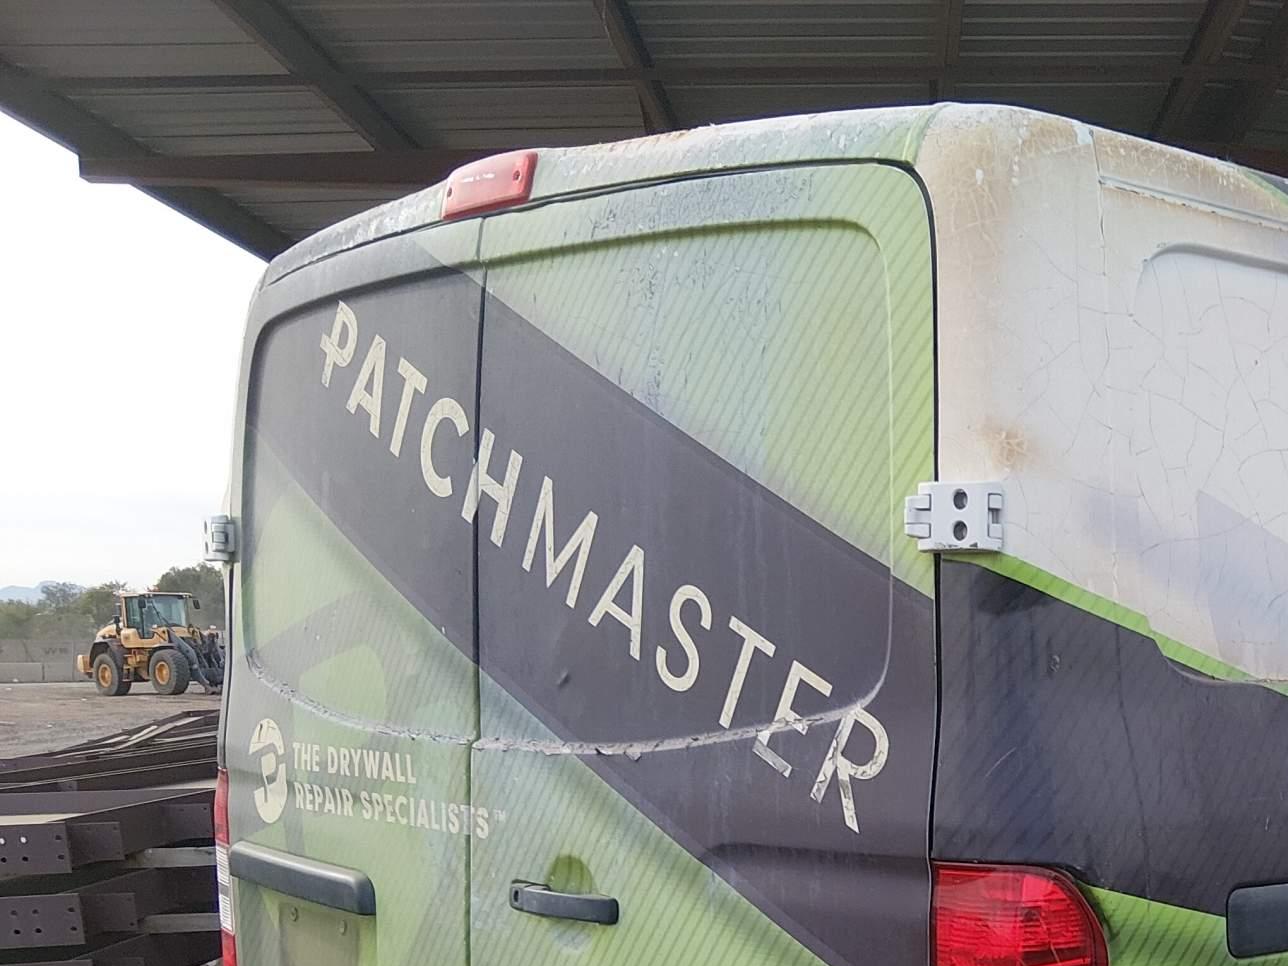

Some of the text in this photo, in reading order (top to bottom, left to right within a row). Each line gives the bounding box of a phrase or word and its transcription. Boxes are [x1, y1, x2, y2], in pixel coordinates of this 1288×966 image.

[320, 300, 889, 834] PATCHMASTER
[292, 742, 417, 785] THE DRYWALL
[294, 782, 354, 817] REPAIR
